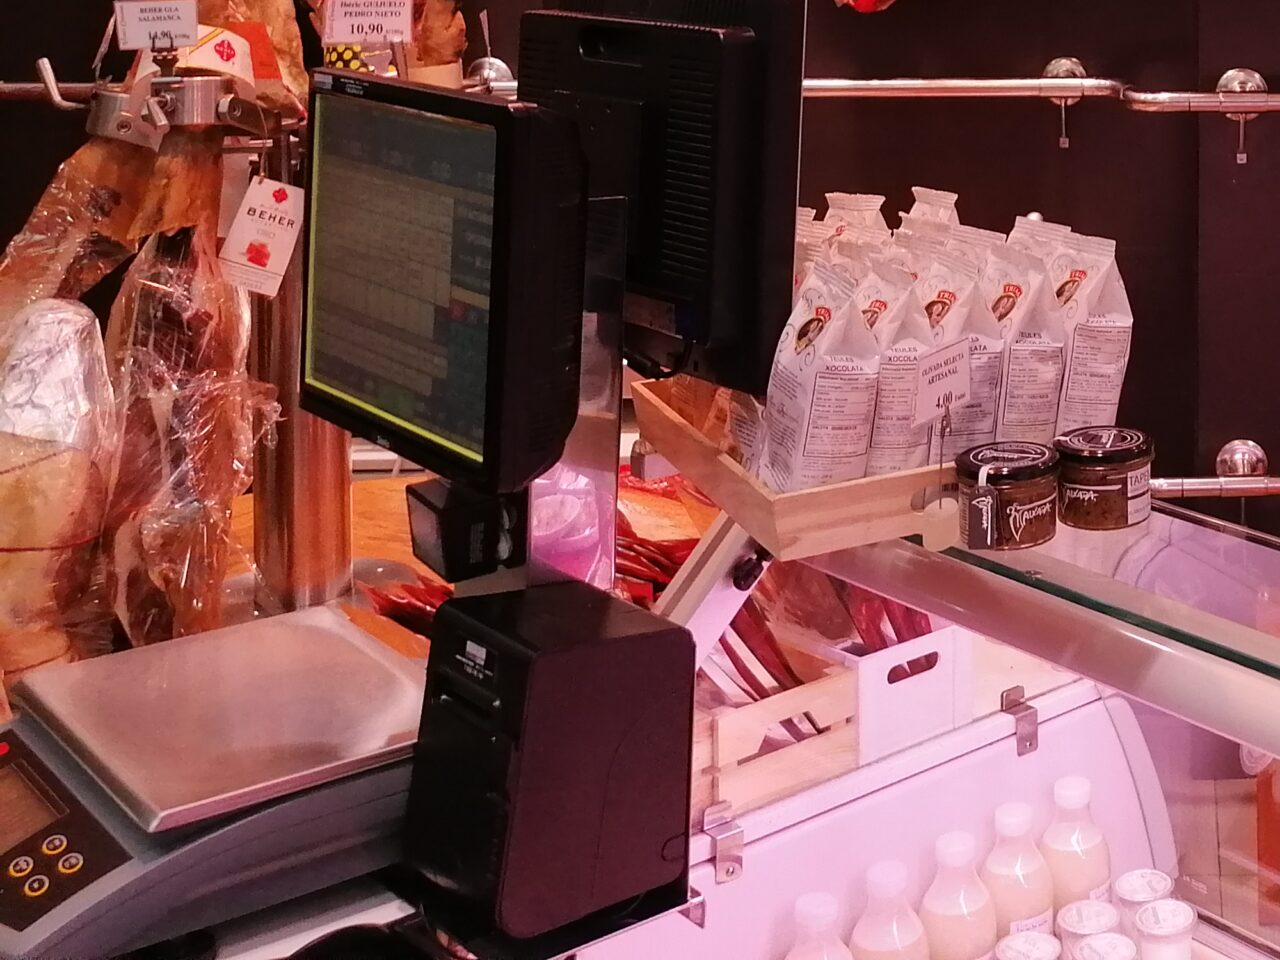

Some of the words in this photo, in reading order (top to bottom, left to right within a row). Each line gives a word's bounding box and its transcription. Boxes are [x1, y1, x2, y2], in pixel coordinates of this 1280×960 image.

[344, 10, 373, 18] PEDRO
[374, 10, 401, 18] NIETO
[350, 23, 384, 35] 10,90
[246, 206, 296, 229] BEHER
[928, 366, 959, 385] ARTESANAL
